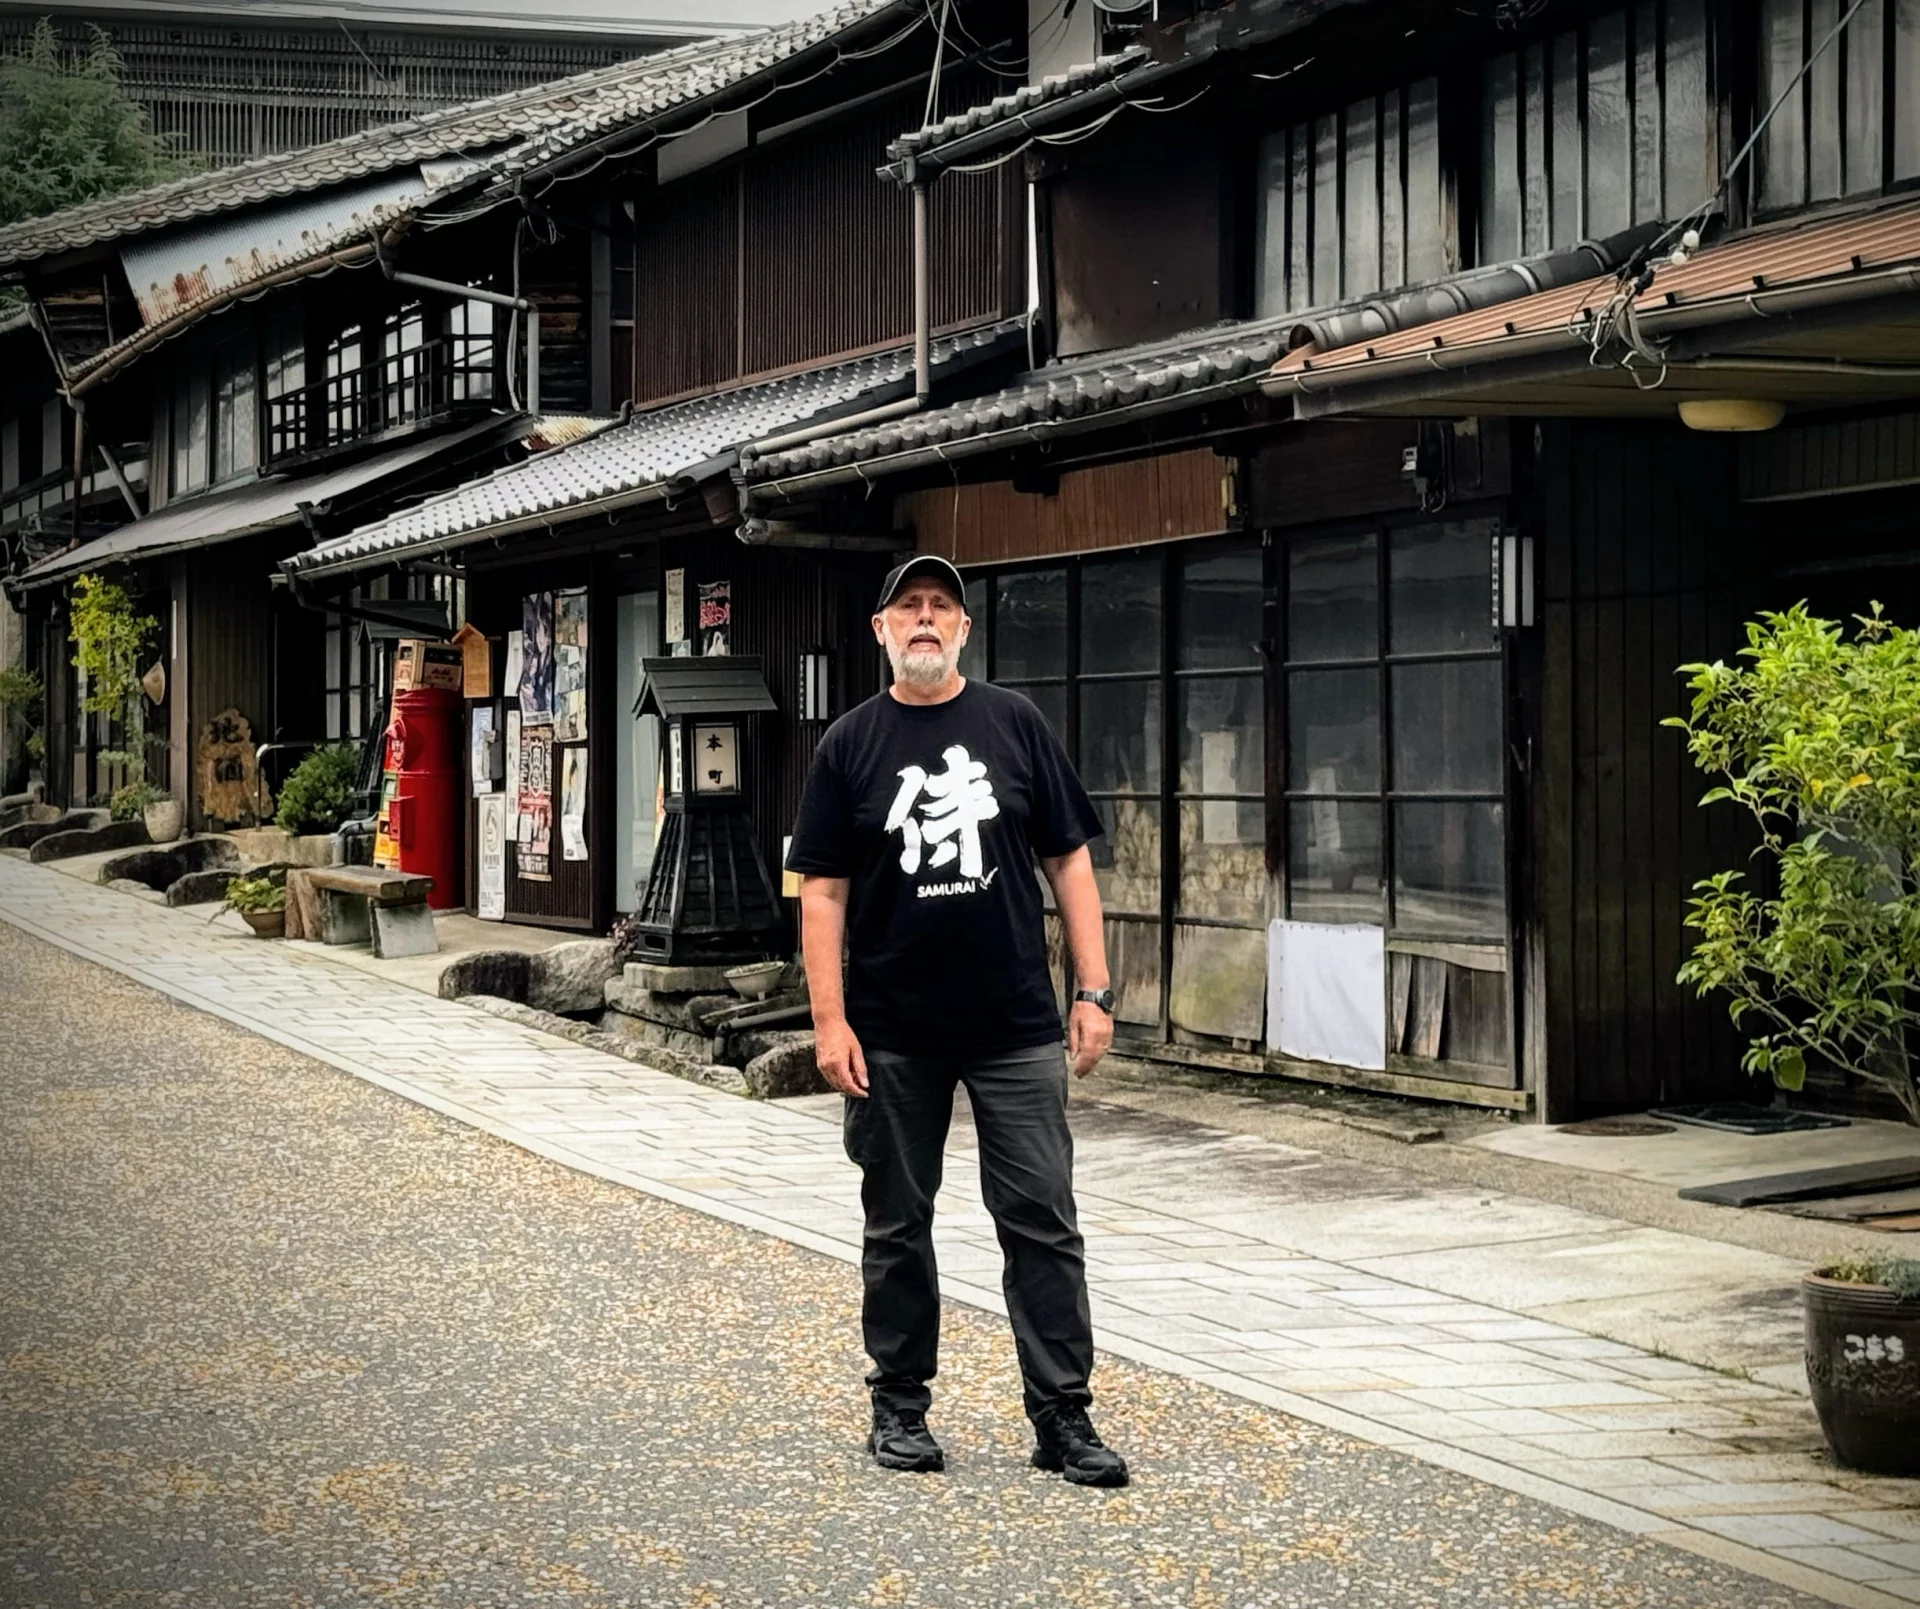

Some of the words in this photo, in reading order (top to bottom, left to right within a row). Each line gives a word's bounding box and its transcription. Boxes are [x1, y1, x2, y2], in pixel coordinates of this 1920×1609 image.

[706, 733, 723, 784] 本町
[884, 744, 1000, 878] 侍
[917, 881, 976, 898] SAMURAI
